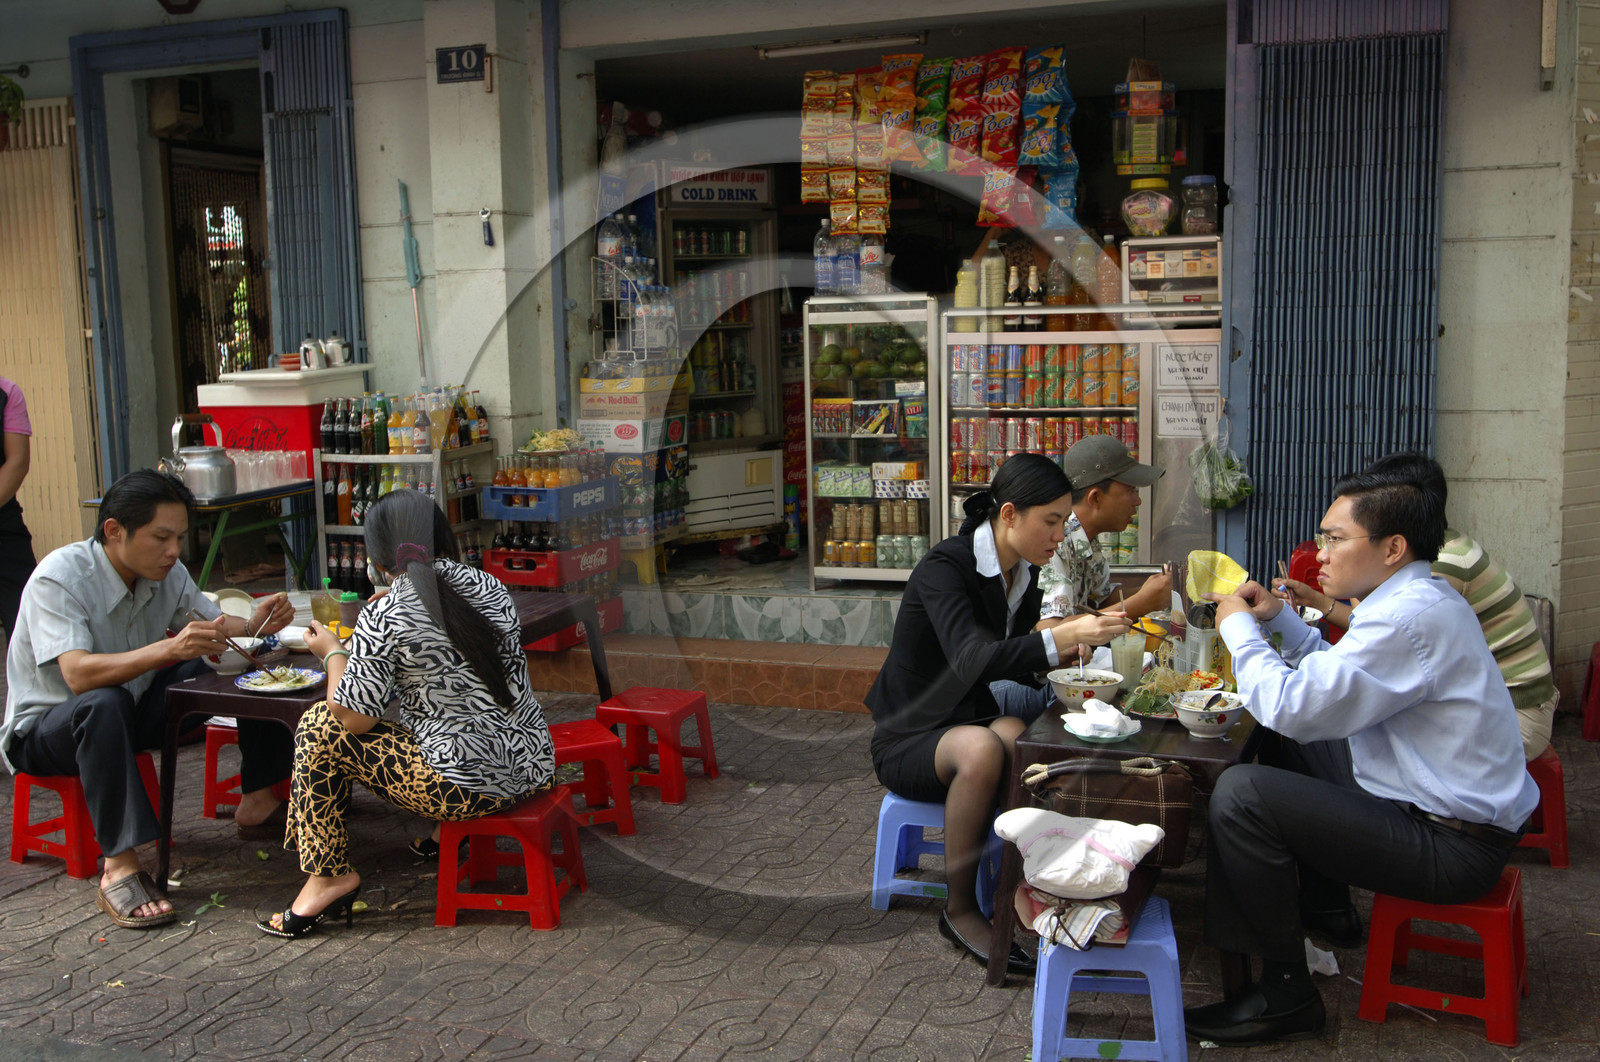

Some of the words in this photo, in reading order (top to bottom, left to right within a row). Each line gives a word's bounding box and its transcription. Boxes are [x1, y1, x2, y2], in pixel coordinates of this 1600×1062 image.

[448, 50, 477, 71] 10
[951, 63, 980, 82] Poca
[984, 73, 1016, 93] Poca
[1025, 72, 1058, 93] Poca
[881, 110, 910, 129] Poca
[913, 120, 939, 138] Poca
[982, 114, 1013, 133] Poca
[948, 123, 978, 142] Poca
[984, 173, 1012, 193] Poca
[681, 187, 715, 200] COLD
[717, 188, 758, 201] DRINK
[607, 396, 623, 405] Red
[623, 396, 639, 405] Bull
[573, 486, 604, 508] PEPSI
